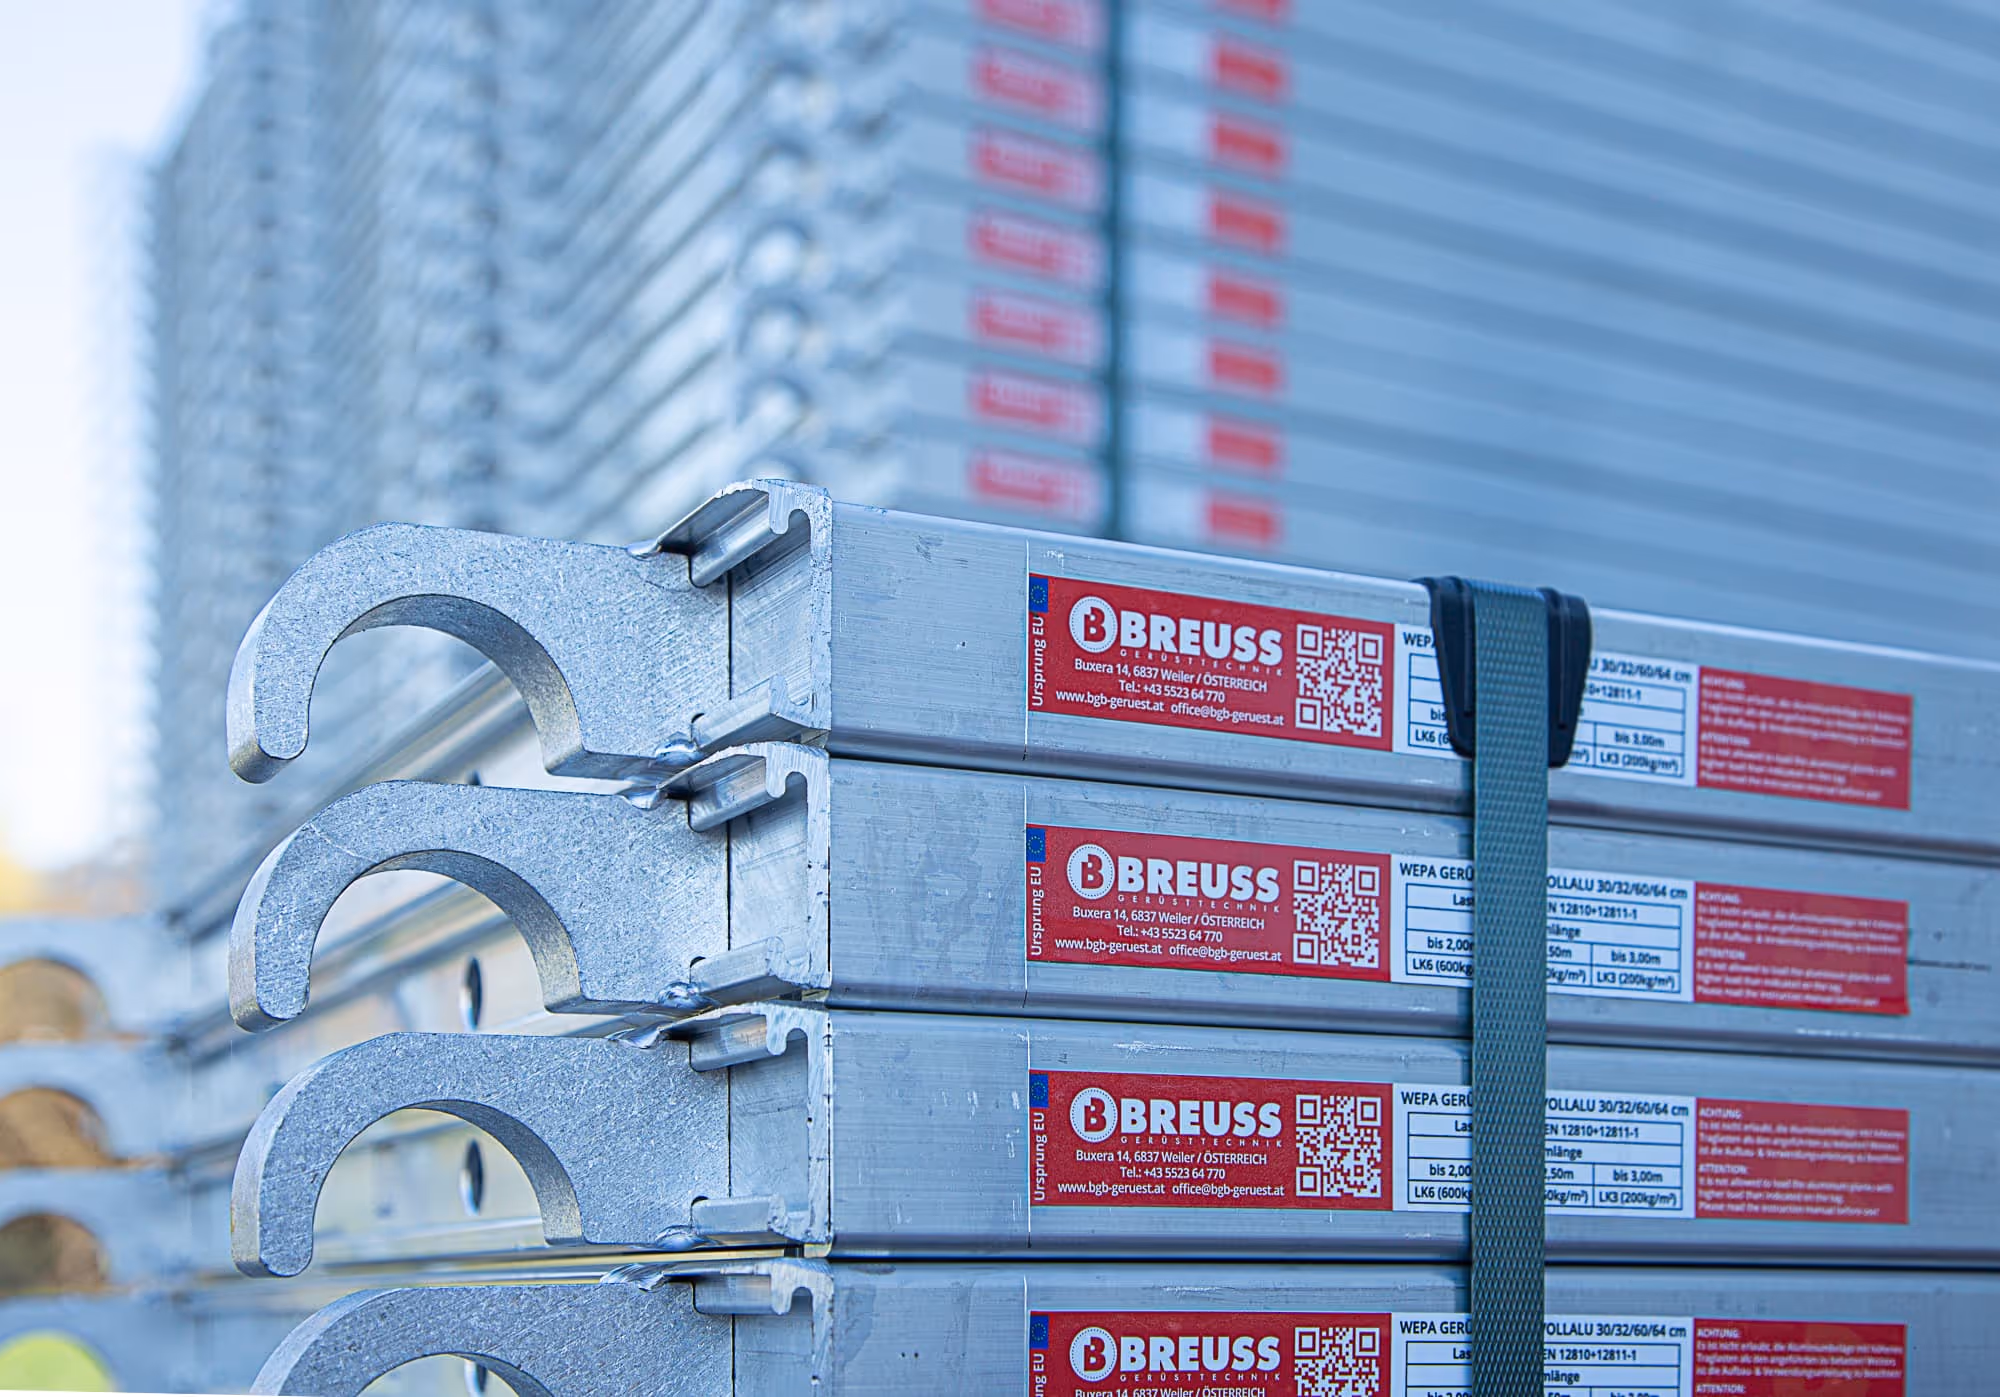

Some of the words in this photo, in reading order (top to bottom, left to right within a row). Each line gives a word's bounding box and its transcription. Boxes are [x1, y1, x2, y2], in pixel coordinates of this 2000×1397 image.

[1032, 617, 1044, 635] EU
[1120, 611, 1282, 666] BREUSS
[1403, 632, 1435, 648] WEP
[1032, 639, 1046, 706] Ursprung
[1075, 658, 1113, 674] Buxera
[1116, 663, 1131, 677] 14,
[1133, 665, 1159, 679] 6837
[1161, 668, 1195, 683] Weiler
[1196, 673, 1202, 684] /
[1203, 672, 1267, 692] ÖSTERREICH
[1674, 672, 1692, 684] cm
[1118, 680, 1140, 693] Tel.:
[1143, 684, 1162, 695] +43
[1164, 685, 1189, 699] 5523
[1191, 688, 1204, 700] 64
[1206, 690, 1225, 703] 770
[1056, 691, 1164, 711] www.bgb-geruest.at
[1171, 702, 1284, 726] office@bgb-geruest.at
[1415, 729, 1436, 744] LK6
[1030, 866, 1041, 885] EU
[1118, 856, 1280, 902] BREUSS
[1400, 862, 1437, 878] WEPA
[1440, 865, 1473, 881] GERÜ
[1546, 875, 1594, 891] OLLALU
[1597, 879, 1667, 897] 30/32/60/64
[1670, 888, 1688, 899] cm
[1453, 893, 1473, 906] Las
[1031, 889, 1045, 955] Ursprung
[1073, 906, 1111, 919] Buxera
[1114, 909, 1129, 922] 14,
[1131, 910, 1157, 922] 6837
[1158, 911, 1192, 924] Weiler
[1194, 914, 1199, 925] /
[1200, 912, 1264, 930] ÖSTERREICH
[1116, 924, 1139, 937] Tel.:
[1141, 927, 1160, 938] +43
[1162, 928, 1187, 940] 5523
[1189, 929, 1202, 941] 64
[1204, 930, 1223, 942] 770
[1055, 938, 1162, 954] www.bgb-geruest.at
[1169, 944, 1282, 962] office@bgb-geruest.at
[1427, 936, 1443, 949] bis
[1412, 958, 1433, 970] LK6
[1611, 951, 1627, 963] bis
[1401, 1091, 1439, 1106] WEPA
[1441, 1092, 1472, 1107] GERÜ
[1598, 1099, 1668, 1115] 30/32/60/64
[1671, 1106, 1689, 1116] cm
[1034, 1112, 1044, 1130] EU
[1121, 1098, 1282, 1138] BREUSS
[1454, 1120, 1473, 1132] Las
[1562, 1124, 1639, 1138] 12810+12811-1
[1076, 1149, 1114, 1161] Buxera
[1117, 1151, 1131, 1163] 14,
[1134, 1151, 1159, 1162] 6837
[1161, 1152, 1195, 1163] Weiler
[1197, 1152, 1202, 1163] /
[1204, 1150, 1267, 1164] ÖSTERREICH
[1034, 1134, 1048, 1200] Ursprung
[1120, 1166, 1141, 1177] Tel.:
[1144, 1167, 1163, 1178] +43
[1165, 1167, 1190, 1178] 5523
[1192, 1168, 1205, 1178] 64
[1207, 1168, 1225, 1179] 770
[1429, 1164, 1446, 1177] bis
[1449, 1165, 1472, 1179] 2,00
[1613, 1169, 1628, 1182] bis
[1631, 1171, 1663, 1183] 3,00m
[1058, 1181, 1165, 1196] www.bgb-geruest.at
[1172, 1183, 1284, 1198] office@bgb-geruest.at
[1414, 1186, 1435, 1199] LK6
[1599, 1191, 1619, 1203] LK3
[1400, 1320, 1437, 1334] WEPA
[1440, 1318, 1472, 1334] GERÜ
[1596, 1322, 1666, 1337] 30/32/60/64
[1669, 1327, 1687, 1337] cm
[1120, 1336, 1280, 1371] BREUSS
[1453, 1347, 1471, 1359] Las
[1560, 1348, 1637, 1361] 12810+12811-1
[1033, 1353, 1044, 1371] EU
[1116, 1389, 1128, 1397] 14
